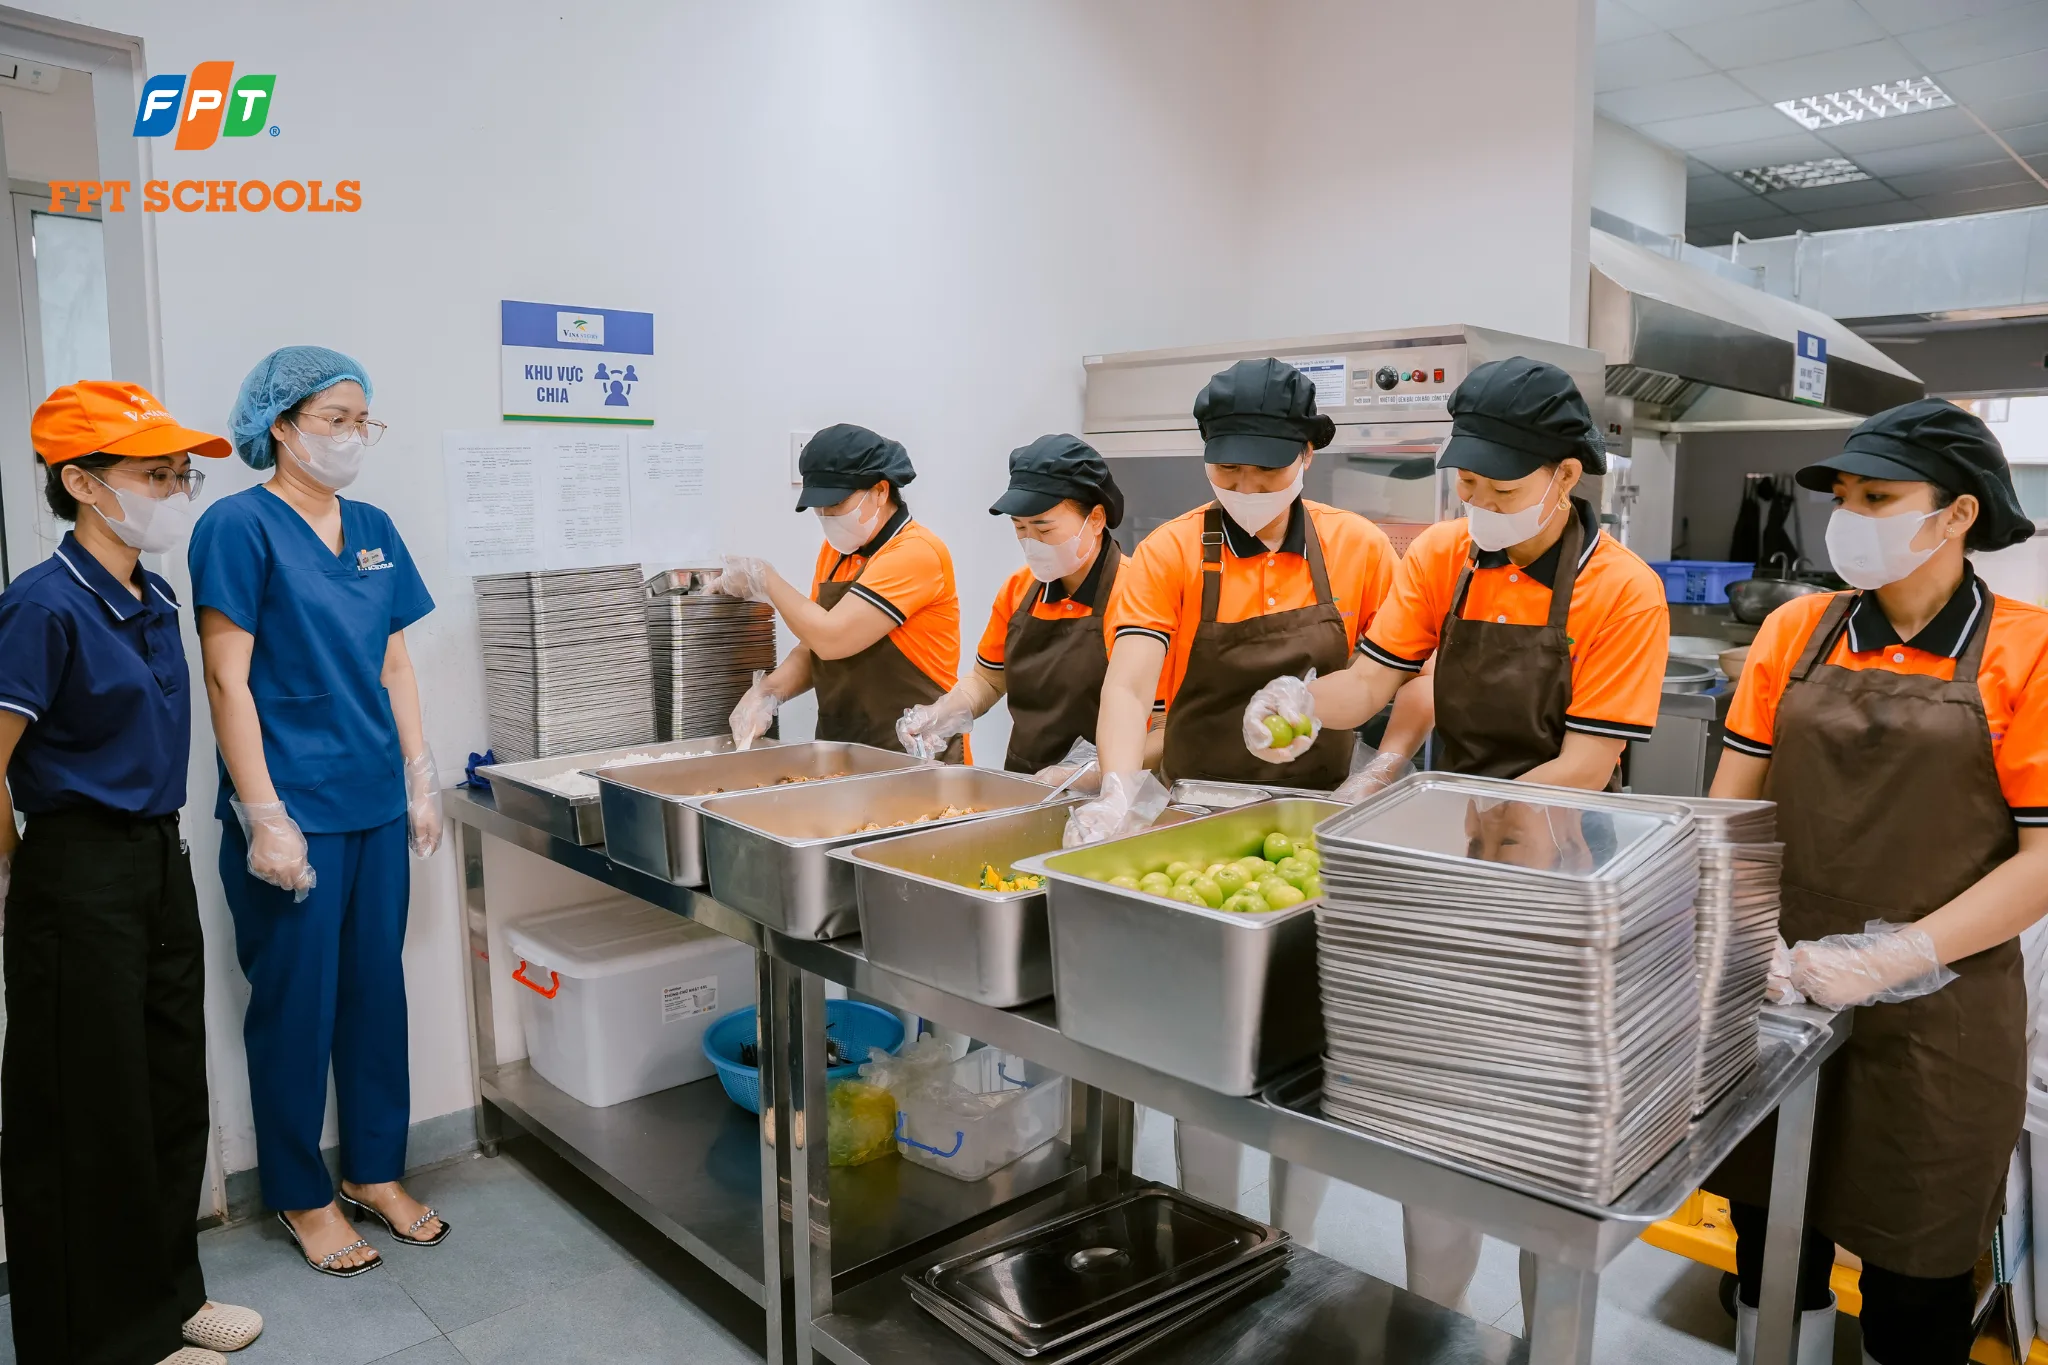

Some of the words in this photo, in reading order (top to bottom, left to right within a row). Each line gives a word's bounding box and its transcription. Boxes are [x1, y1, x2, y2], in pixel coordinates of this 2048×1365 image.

[524, 365, 553, 381] KHU
[557, 365, 584, 386] VỰC
[536, 387, 569, 404] CHIA
